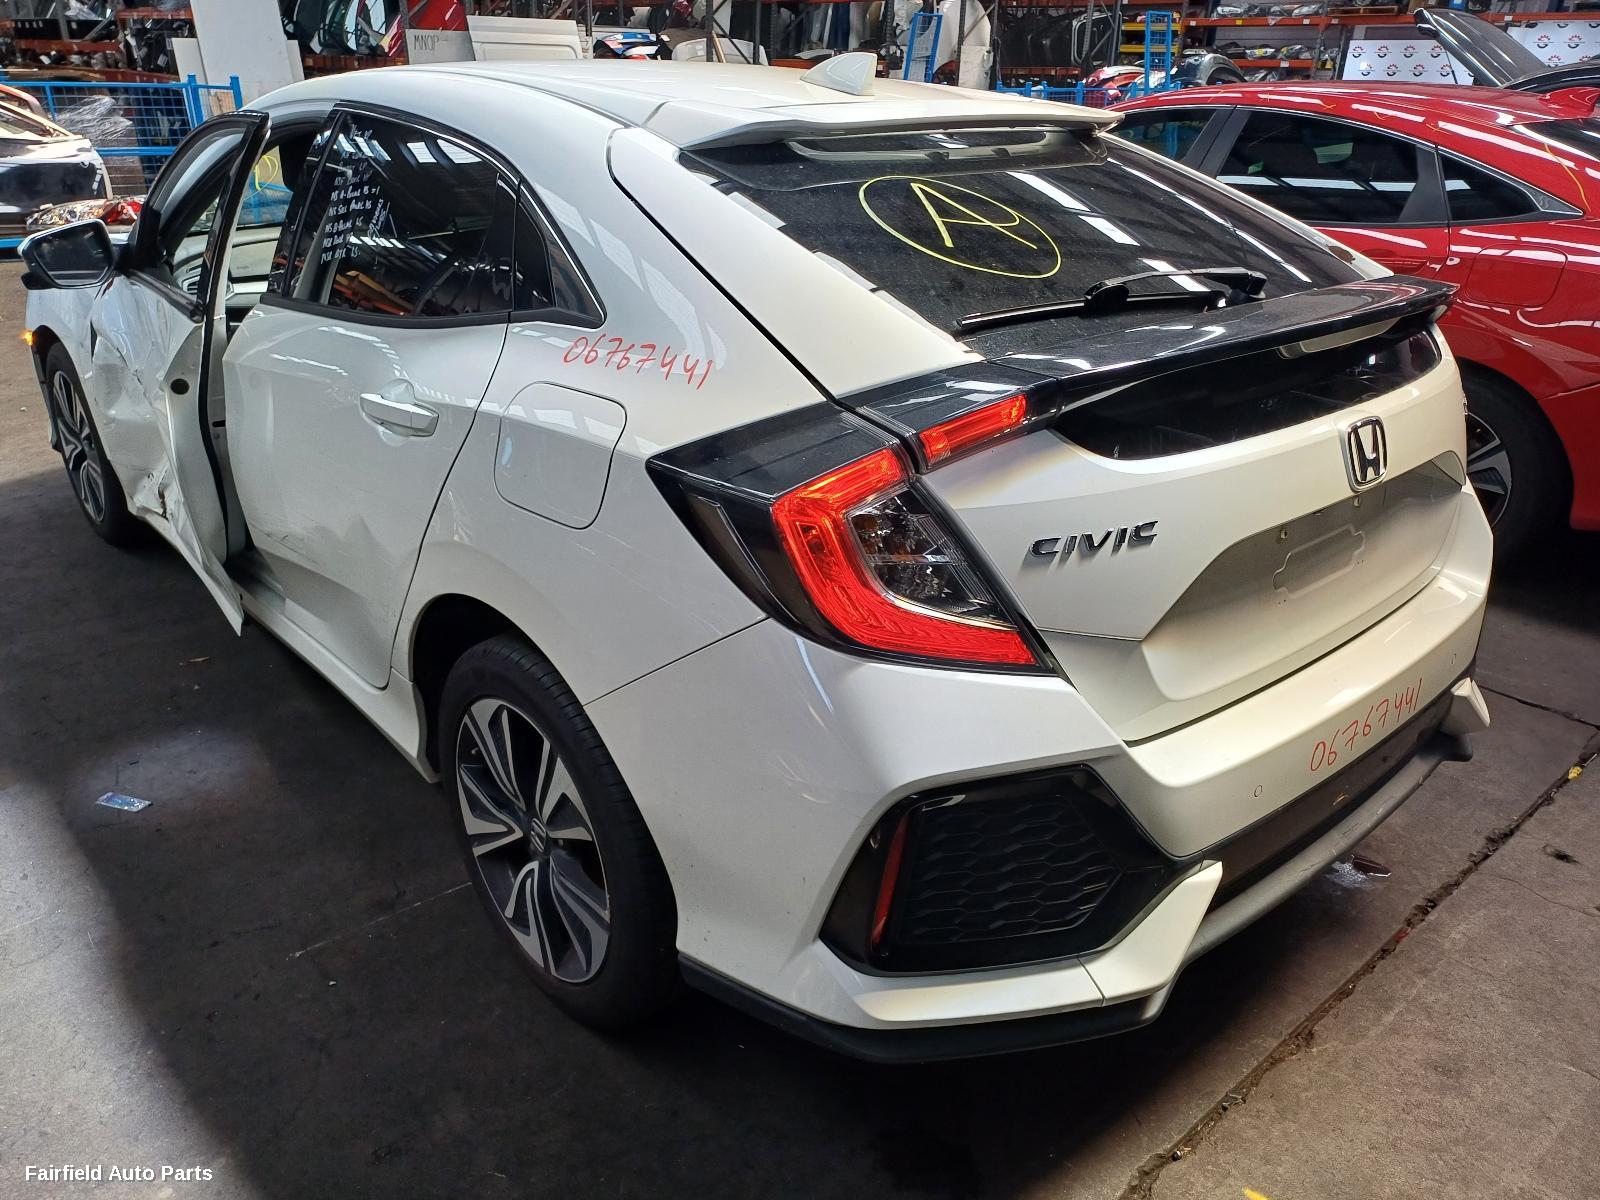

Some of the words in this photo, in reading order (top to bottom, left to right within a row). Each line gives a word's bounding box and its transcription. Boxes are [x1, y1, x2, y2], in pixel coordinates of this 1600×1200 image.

[414, 34, 440, 50] MNOP
[563, 333, 714, 390] 06767441
[1030, 520, 1159, 556] CIVIC
[1310, 677, 1423, 772] 06767441
